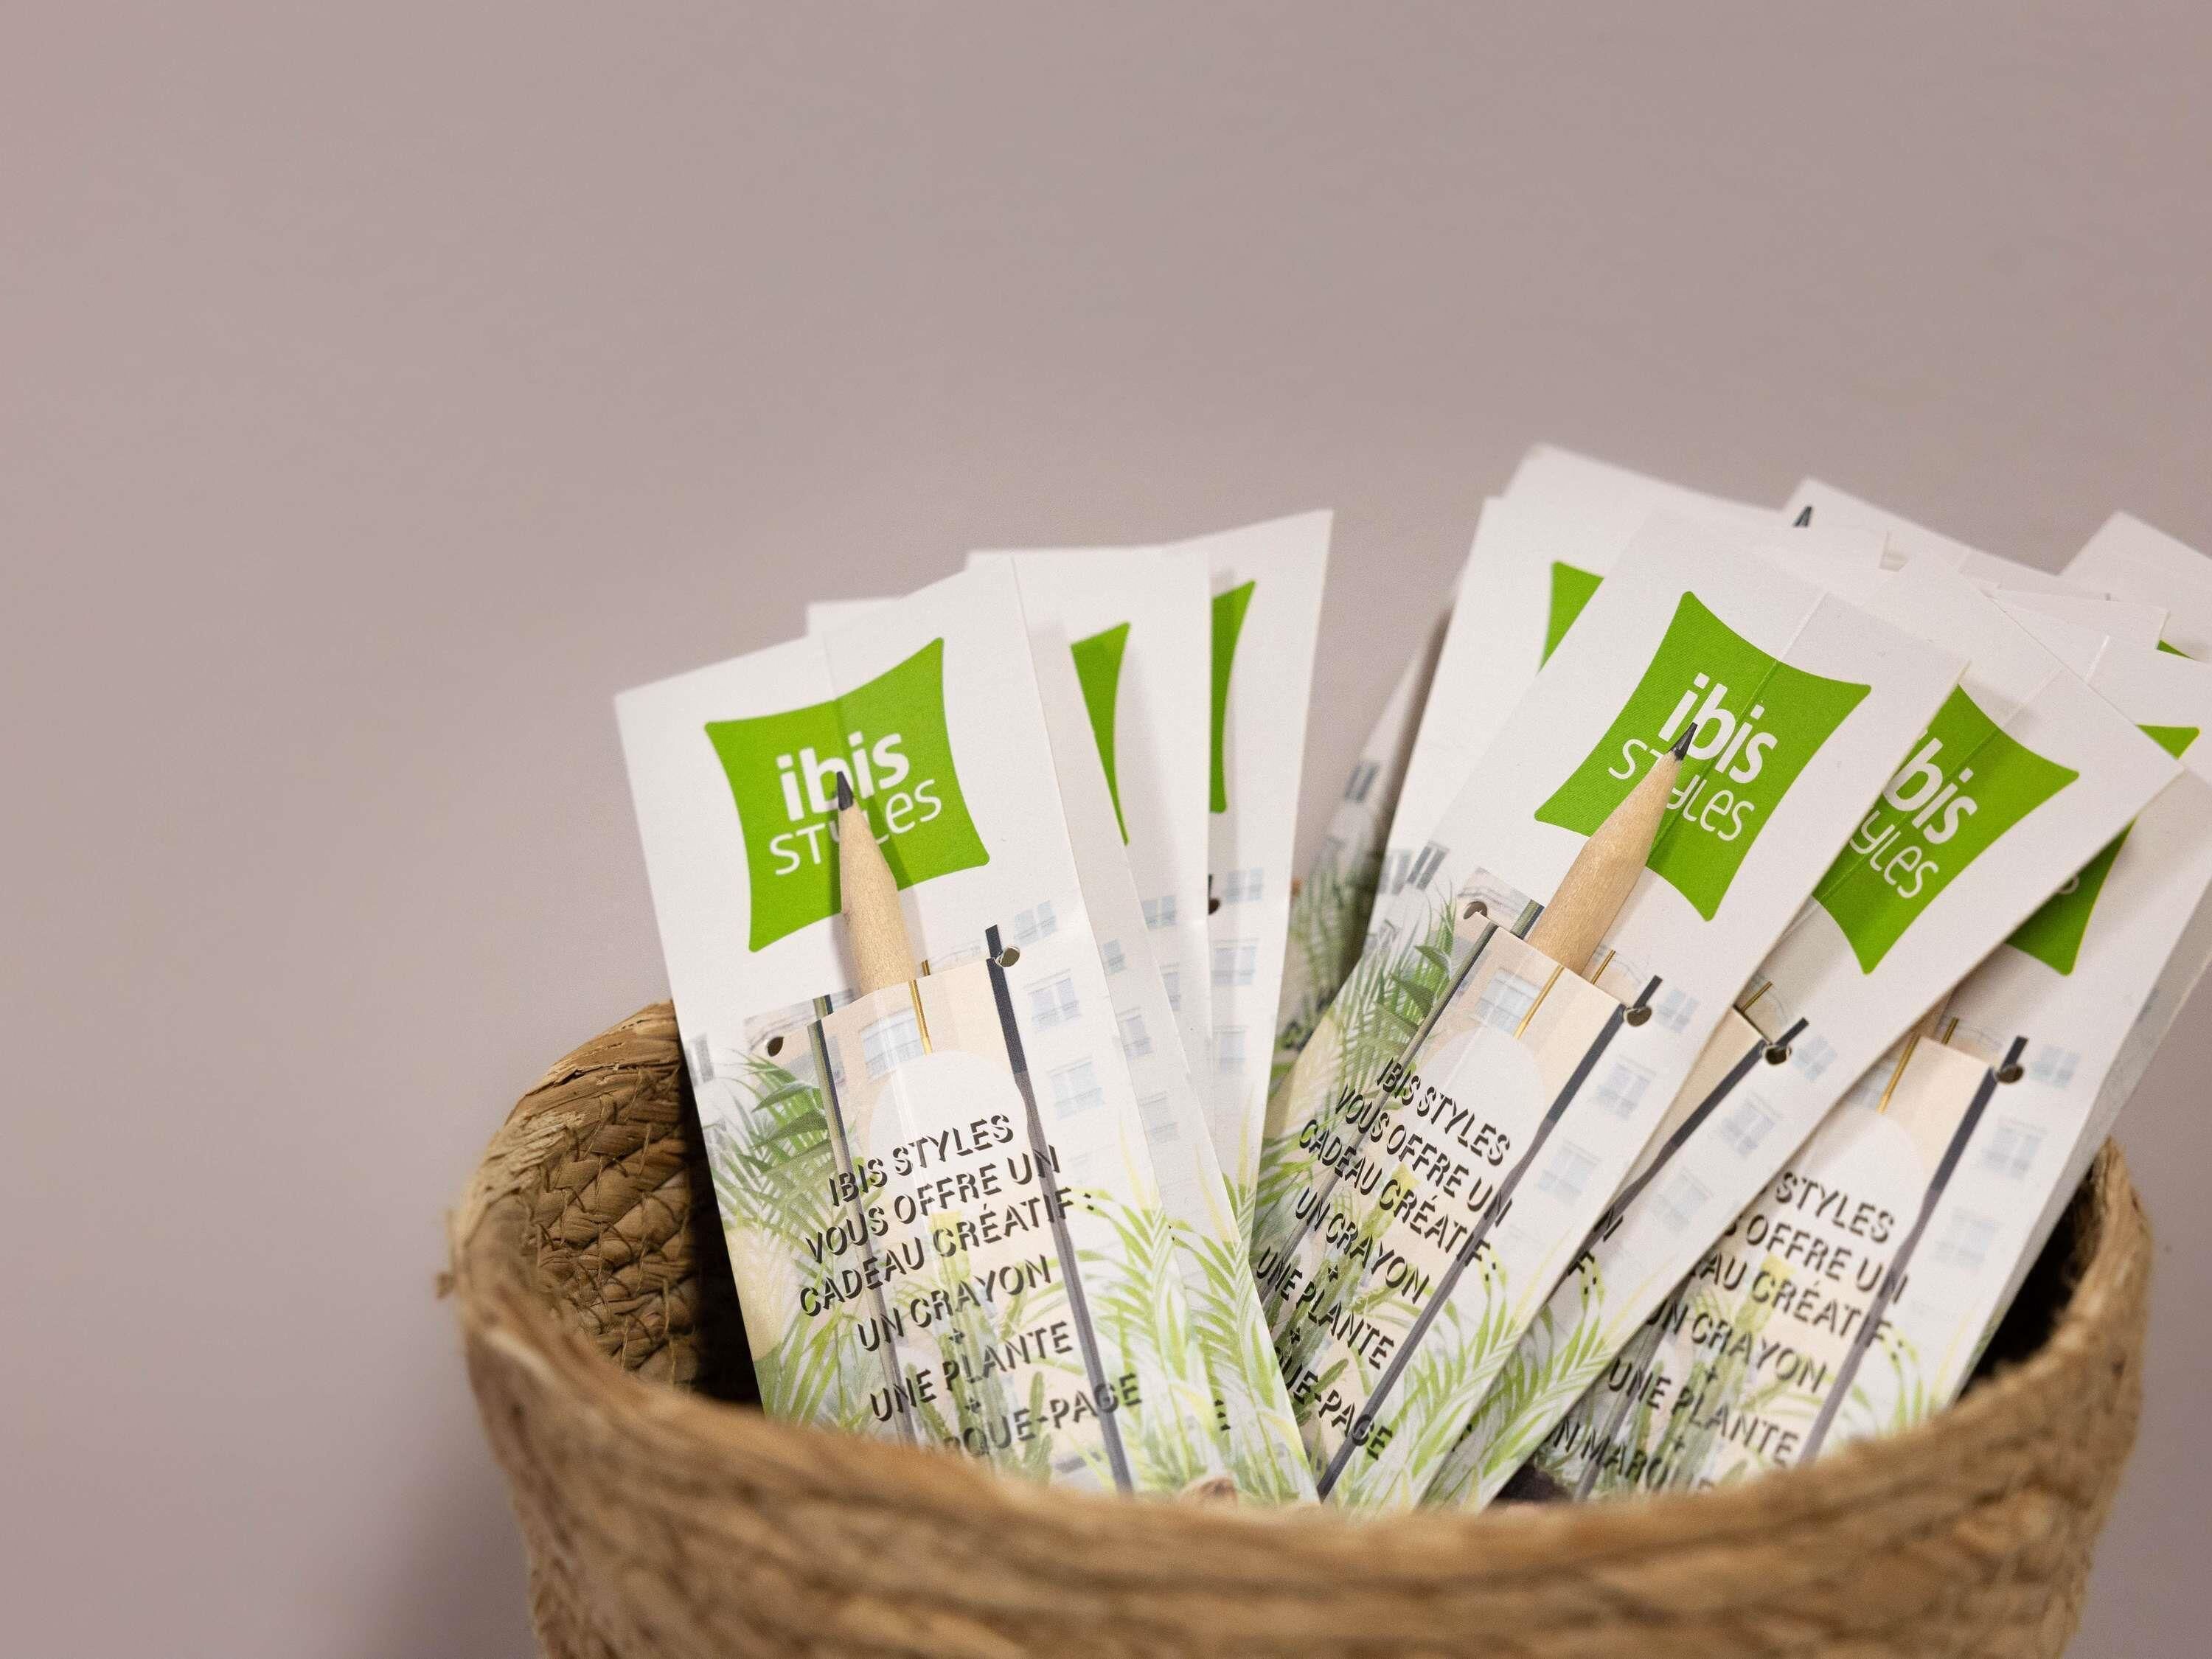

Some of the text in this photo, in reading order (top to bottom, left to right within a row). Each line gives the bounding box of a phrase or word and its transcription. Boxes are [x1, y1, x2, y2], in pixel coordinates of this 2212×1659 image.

[776, 731, 910, 822] ibis
[1658, 672, 1778, 783] ibis
[1882, 730, 1978, 844] bis
[828, 1114, 1014, 1207] IBIS STYLES
[1335, 1084, 1512, 1228] VOUS OFFRE UN
[1377, 1057, 1510, 1166] IBIS STYLES
[806, 1144, 1060, 1264] VOUS OFFRE UN
[1295, 1186, 1431, 1305] UN CRAYON
[1299, 1119, 1382, 1195] CADEAU
[1380, 1179, 1490, 1267] CRÉATIF
[1746, 1214, 1851, 1281] OFFRE
[1775, 1172, 1895, 1244] STYLES
[800, 1237, 925, 1317] CADEAU
[933, 1187, 1074, 1258] CRÉATIF
[858, 1254, 1051, 1352] UN CRAYON
[1256, 1245, 1394, 1370] UNE PLANTE
[1691, 1313, 1827, 1394] CRAYON
[870, 1321, 1074, 1422] UNE PLANTE
[1608, 1358, 1798, 1468] UNE PLANTE
